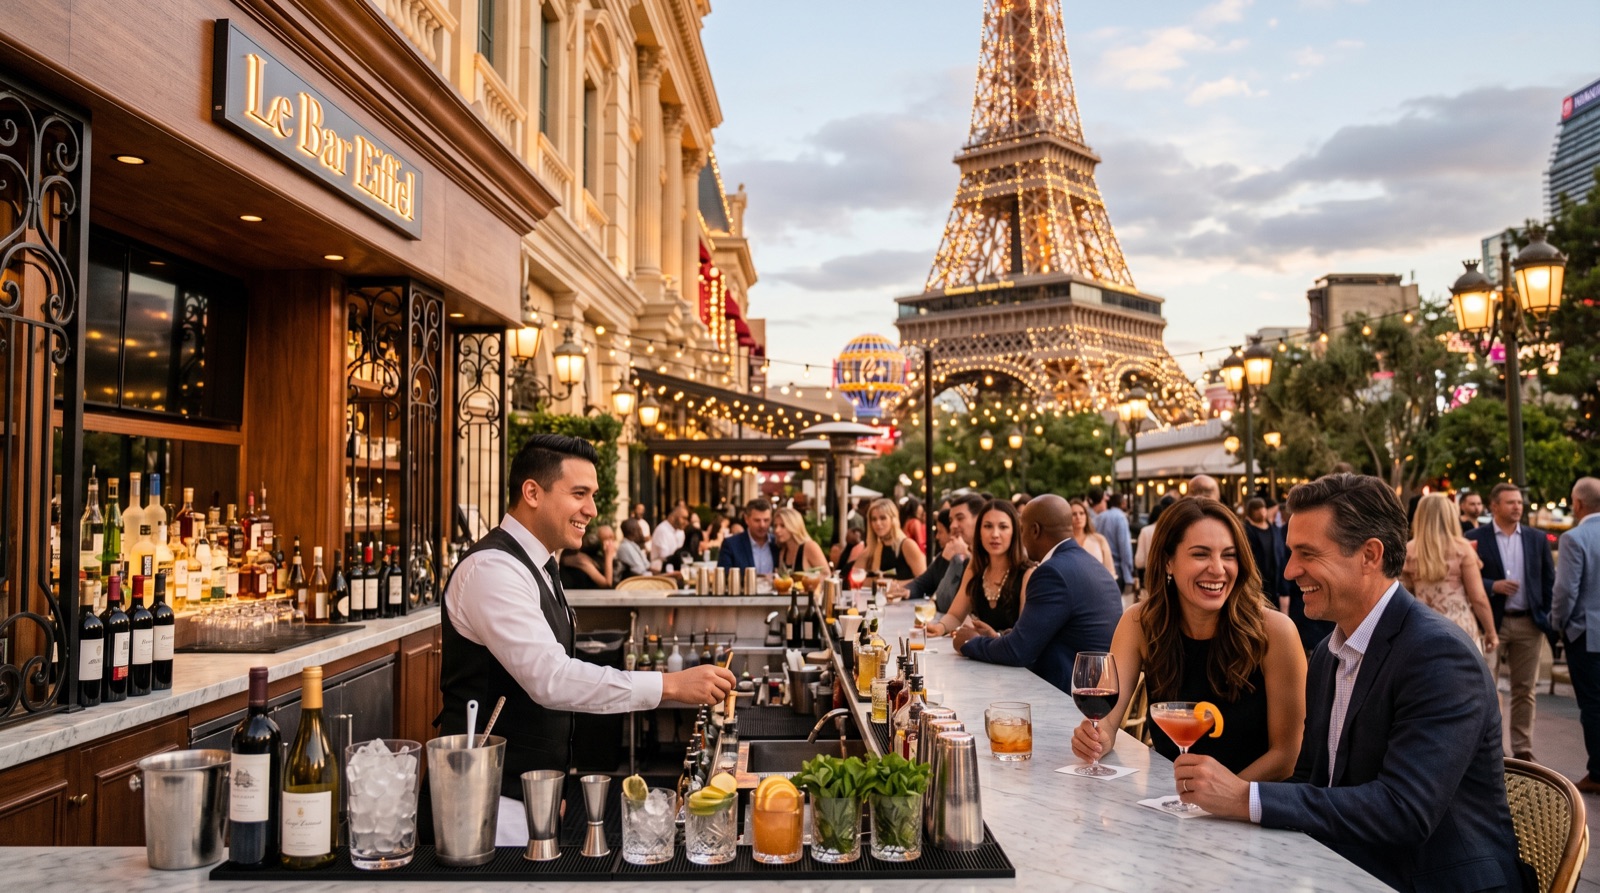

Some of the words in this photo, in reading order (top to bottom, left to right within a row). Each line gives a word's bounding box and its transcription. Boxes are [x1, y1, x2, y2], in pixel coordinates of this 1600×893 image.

[246, 54, 294, 138] Le
[298, 92, 352, 176] Bar
[355, 135, 415, 221] Eiffel
